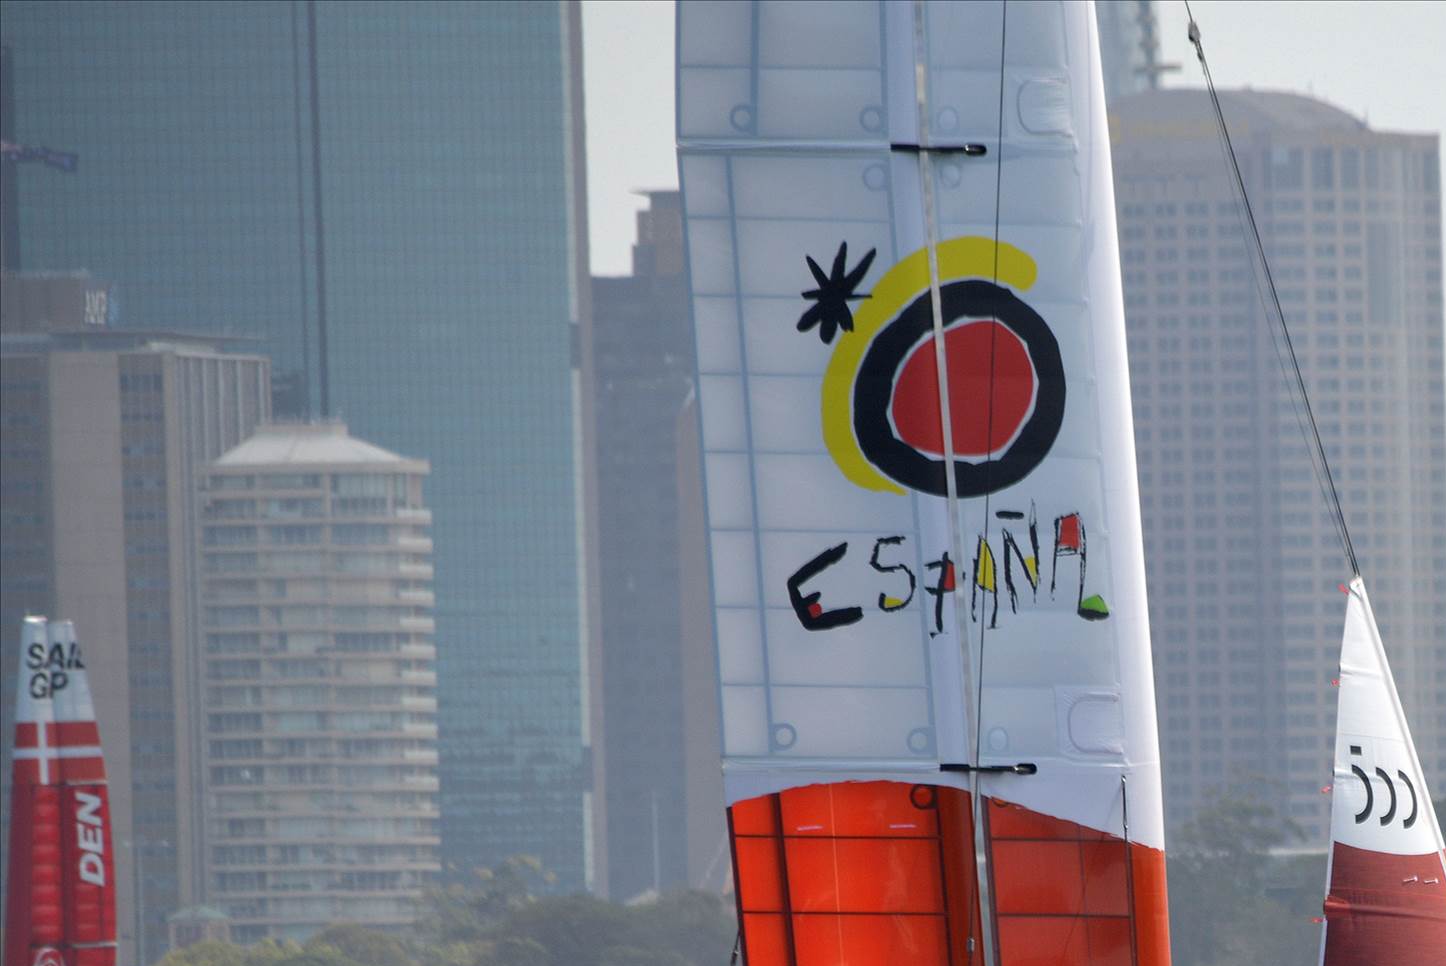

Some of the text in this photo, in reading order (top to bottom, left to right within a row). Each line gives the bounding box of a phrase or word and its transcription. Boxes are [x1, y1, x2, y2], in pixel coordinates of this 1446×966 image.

[27, 642, 85, 670] SAIL
[30, 672, 69, 699] GP
[75, 792, 105, 887] DEN
